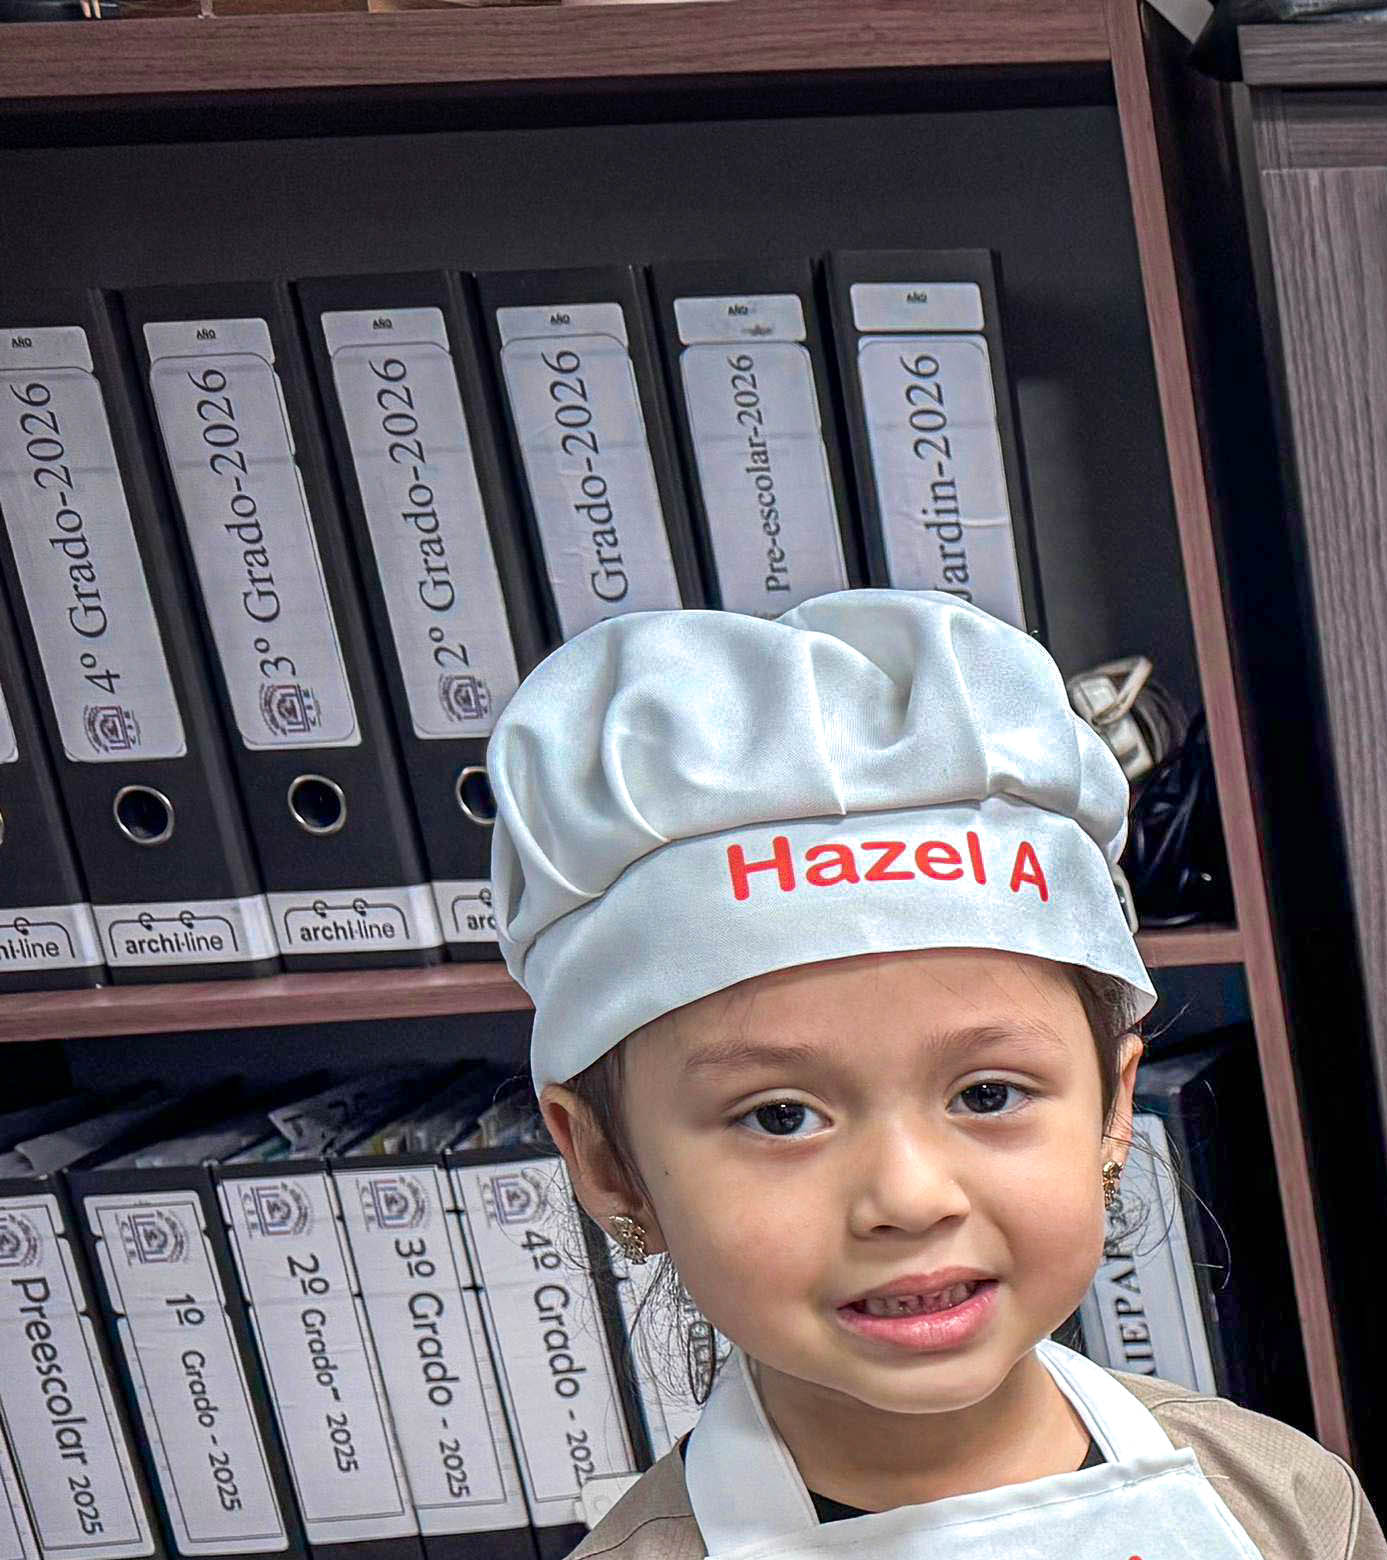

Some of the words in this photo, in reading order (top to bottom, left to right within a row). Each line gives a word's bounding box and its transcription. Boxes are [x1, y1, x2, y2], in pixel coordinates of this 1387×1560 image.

[18, 381, 108, 638] Grado-2026
[196, 367, 280, 624] Grado-2026
[368, 357, 456, 612] Grado-2026
[545, 349, 627, 602] Grado-2026
[733, 353, 790, 593] Pre-escolar-2026
[727, 831, 987, 901] Hazel
[1009, 841, 1049, 902] A
[12, 1276, 87, 1466] Preescolar
[69, 1474, 105, 1536] 2025
[181, 1349, 215, 1429] Grado
[208, 1451, 243, 1513] 2025
[326, 1412, 359, 1475] 2025
[408, 1292, 460, 1406] Grado
[440, 1438, 471, 1498] 2025
[533, 1284, 586, 1400] Grado
[566, 1429, 594, 1485] 202
